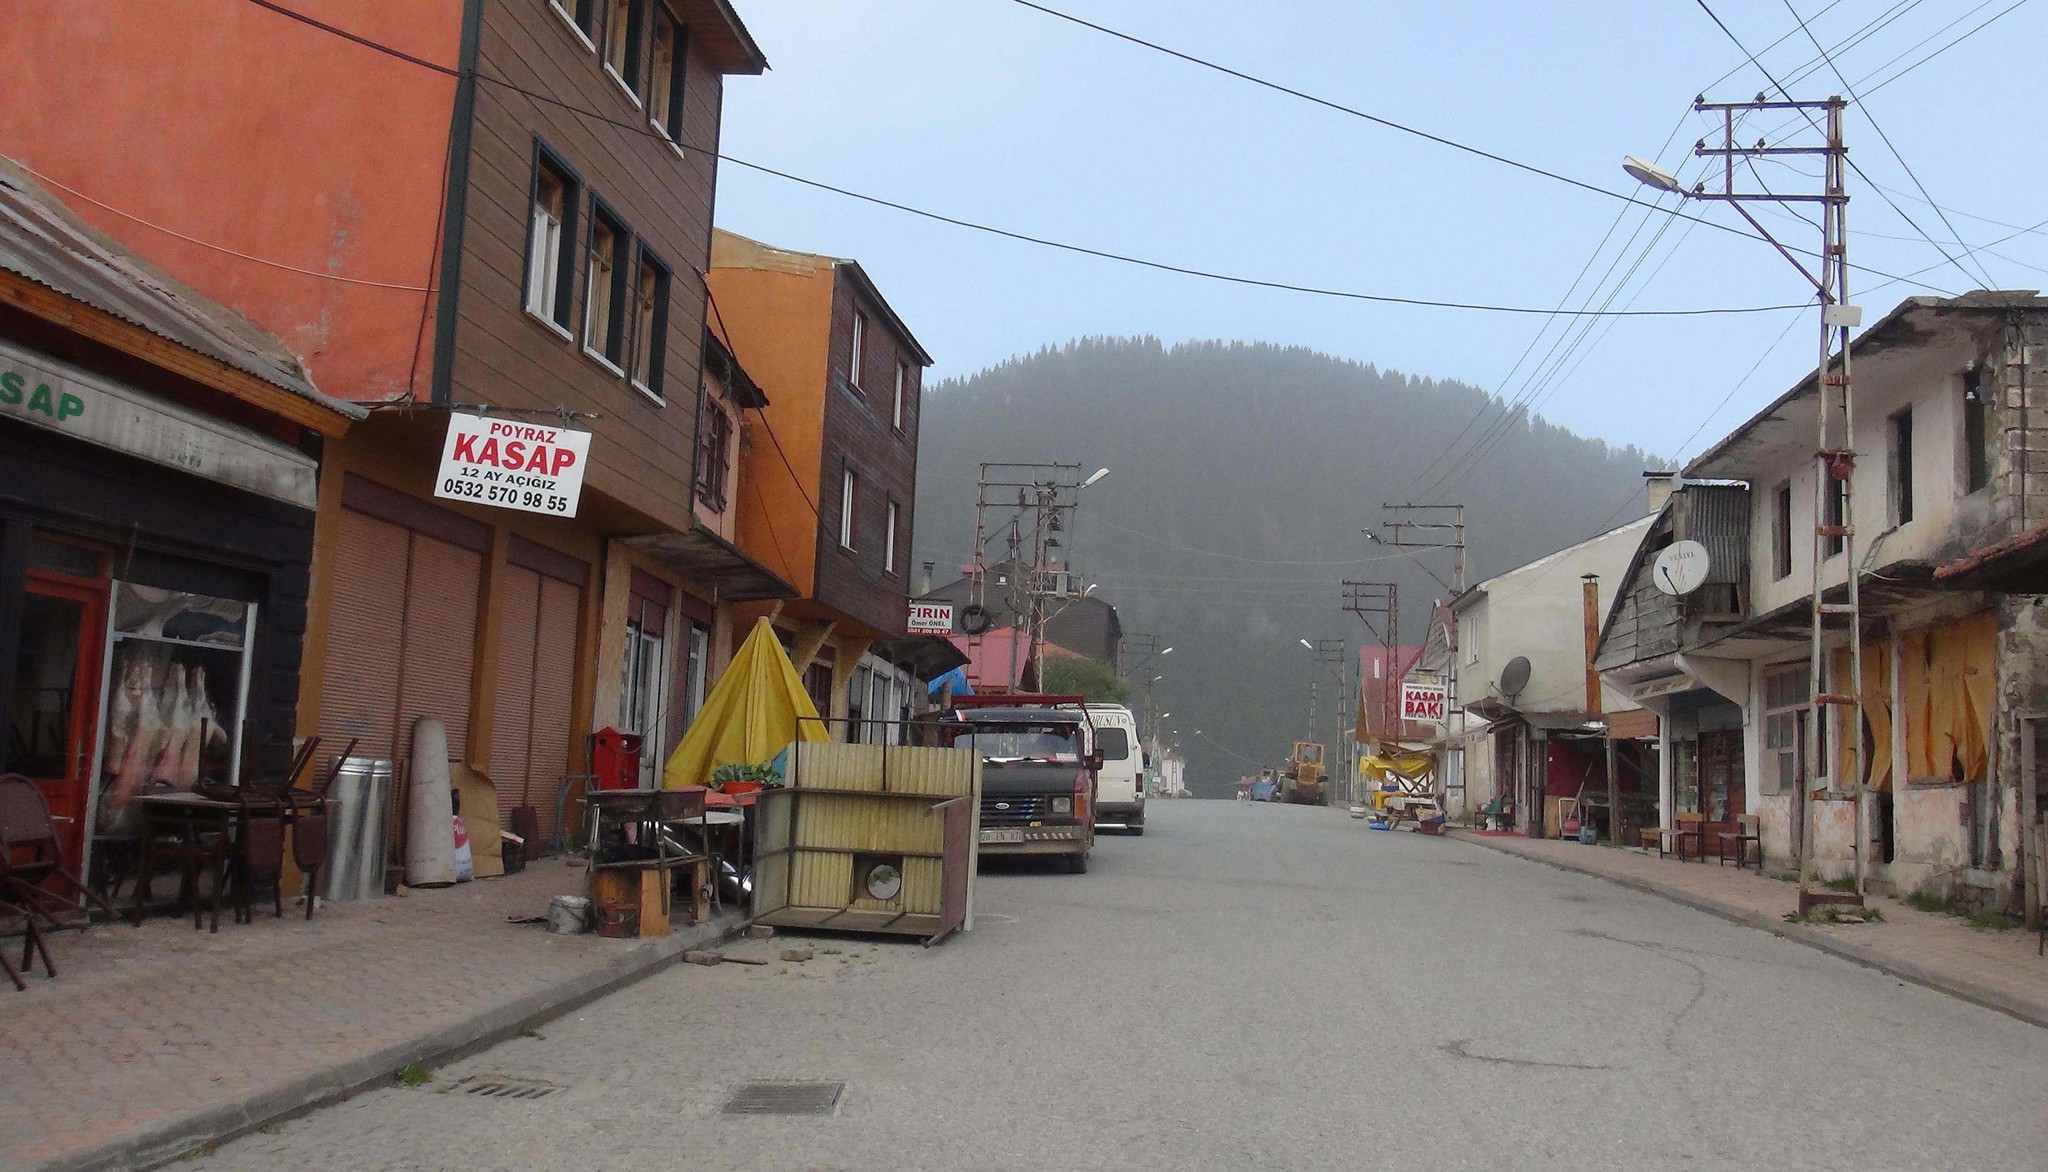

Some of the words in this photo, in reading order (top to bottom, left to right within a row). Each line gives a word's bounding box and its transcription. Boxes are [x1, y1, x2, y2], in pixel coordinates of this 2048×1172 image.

[490, 423, 557, 444] POYRAZ
[453, 433, 576, 476] KASAP
[461, 467, 479, 478] 12
[484, 471, 502, 481] AY
[505, 475, 556, 491] AÇIĞIZ
[444, 479, 484, 498] 0532
[488, 486, 518, 504] 570
[523, 491, 543, 508] 98
[547, 496, 568, 512] 55
[909, 608, 949, 618] FIRIN
[1406, 691, 1444, 702] KASAP
